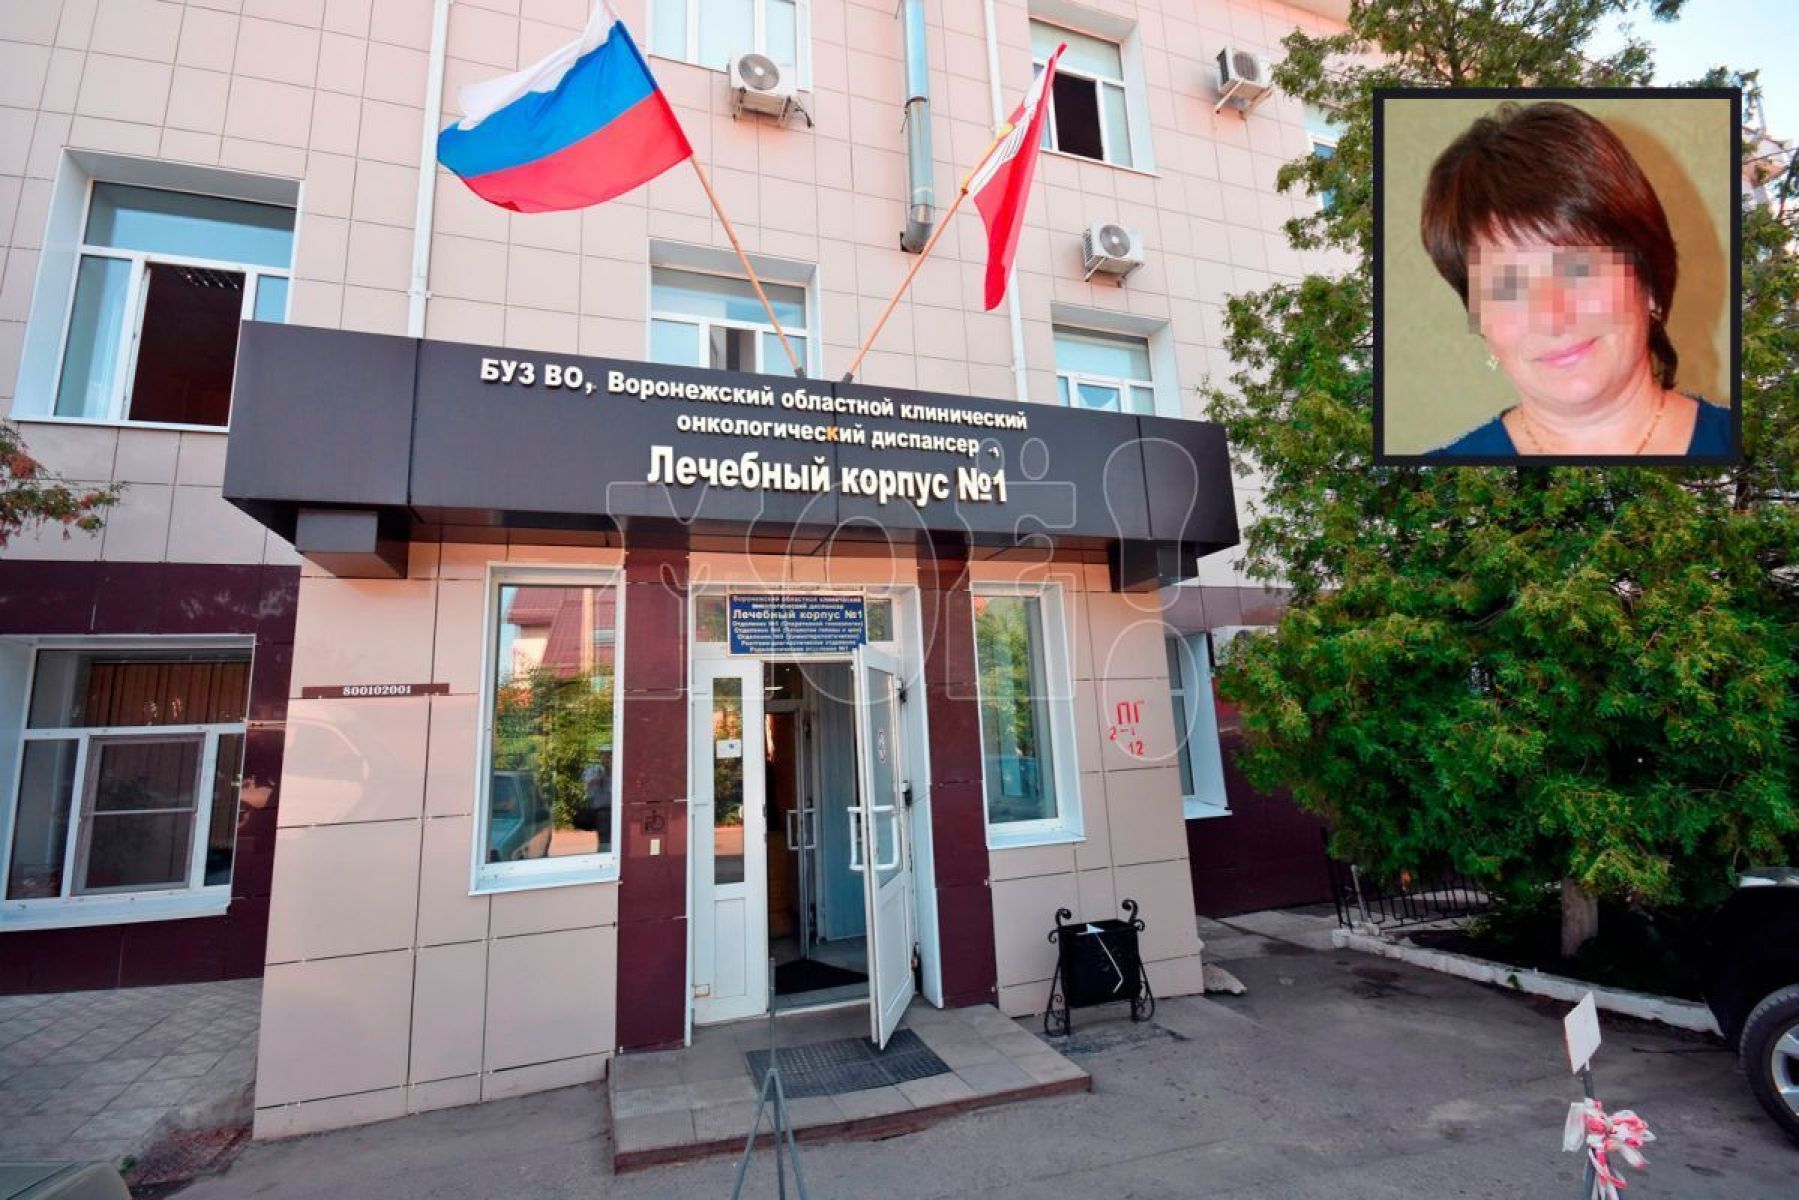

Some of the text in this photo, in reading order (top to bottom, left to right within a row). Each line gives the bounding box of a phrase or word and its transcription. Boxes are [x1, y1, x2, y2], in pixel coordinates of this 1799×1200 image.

[480, 357, 1028, 430] БУЗ ВО, Воронежский областной клинический
[676, 414, 980, 457] онкологический диспансер
[647, 444, 1008, 507] Лечебный корпус №1
[733, 609, 796, 619] Лечебный
[799, 611, 841, 622] корпус
[342, 685, 412, 696] 800102001
